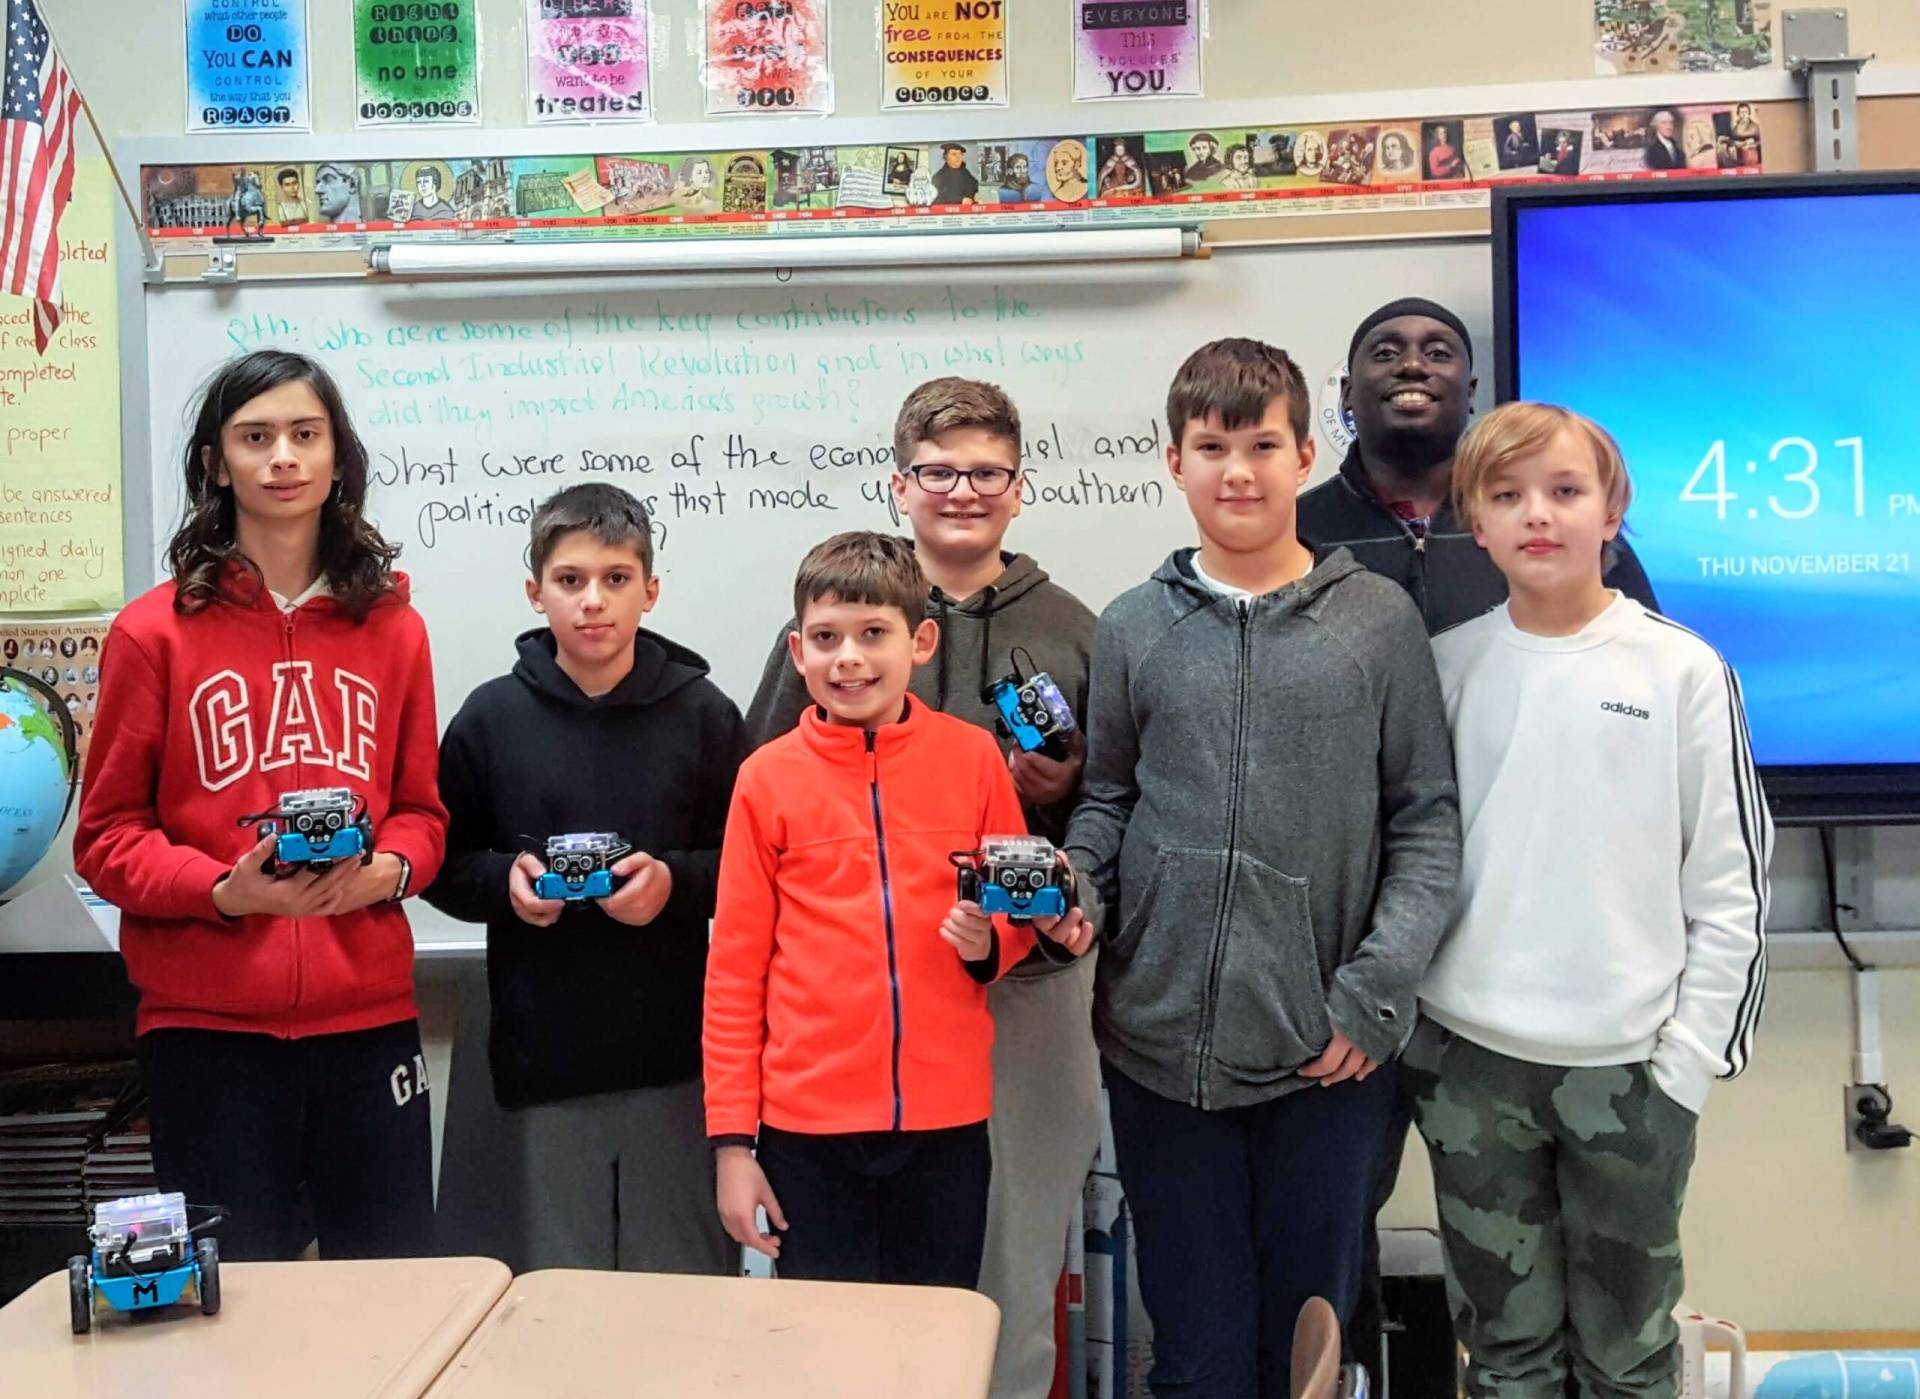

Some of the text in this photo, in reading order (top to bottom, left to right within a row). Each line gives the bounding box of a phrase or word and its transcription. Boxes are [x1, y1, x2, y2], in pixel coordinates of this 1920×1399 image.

[260, 10, 287, 21] people
[955, 1, 1002, 20] NOT
[227, 25, 266, 42] DO.
[884, 24, 1003, 43] free FROM THE
[242, 49, 292, 68] CAN
[887, 49, 1003, 63] CONSEQUENCES
[1099, 53, 1179, 67] INCLUDES
[215, 75, 282, 86] CONTROL
[378, 65, 457, 81] no one
[610, 73, 625, 86] be
[915, 69, 974, 80] OF YOUR
[1107, 69, 1171, 93] YOU.
[274, 92, 291, 102] you
[203, 106, 295, 124] REACT.
[361, 101, 477, 118] looking.
[460, 319, 533, 342] some
[543, 304, 574, 349] of
[594, 299, 637, 335] the
[656, 301, 712, 345] key
[736, 296, 917, 331] contributors
[59, 329, 96, 348] class
[356, 356, 451, 390] Second
[637, 343, 797, 380] Revolution
[367, 399, 423, 428] did
[8, 426, 71, 456] proper
[578, 448, 655, 474] some
[670, 435, 705, 477] of
[722, 433, 791, 471] the
[1093, 417, 1161, 455] and
[1679, 435, 1864, 520] 4:31
[3, 483, 112, 503] be answered
[418, 492, 537, 549] political
[668, 480, 728, 518] that
[748, 483, 839, 511] made
[60, 538, 104, 580] daily
[1697, 552, 1910, 577] THU NOVEMBER 21
[38, 568, 68, 583] one
[21, 627, 48, 637] States
[50, 626, 61, 635] of
[63, 626, 108, 636] America
[1600, 701, 1650, 720] adidas
[188, 660, 379, 793] GAP
